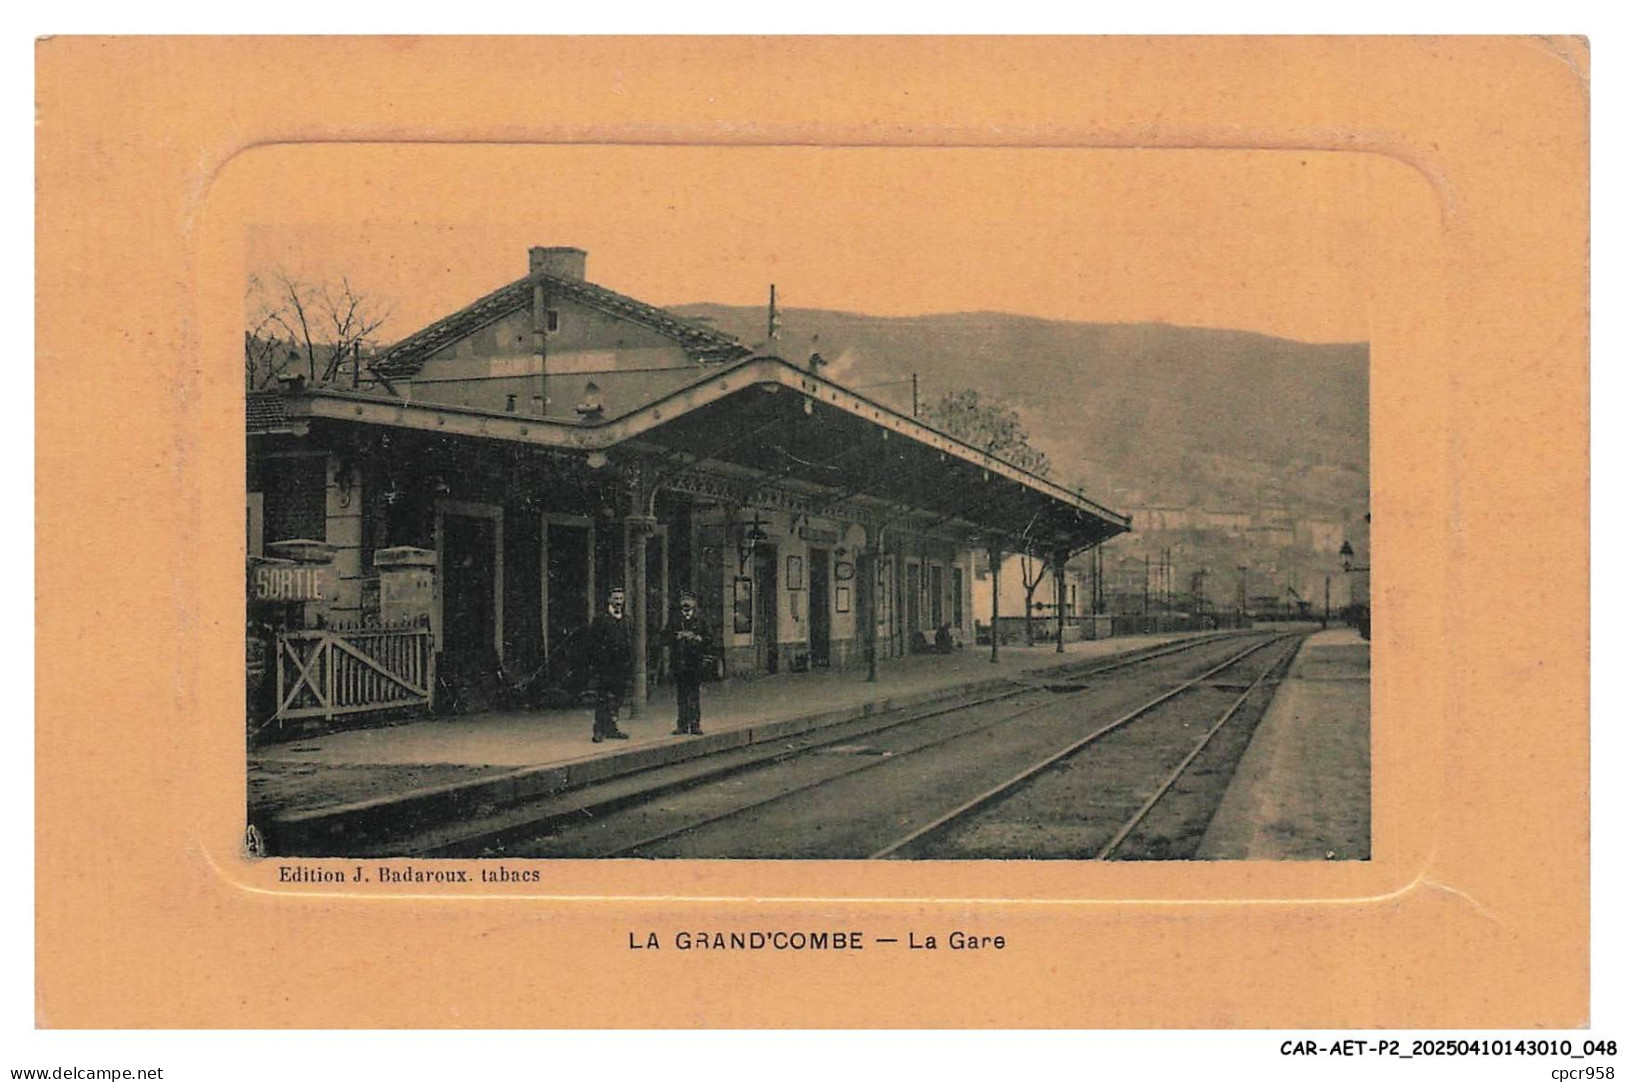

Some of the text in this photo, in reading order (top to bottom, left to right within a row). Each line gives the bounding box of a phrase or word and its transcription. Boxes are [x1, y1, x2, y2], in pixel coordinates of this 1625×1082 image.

[257, 568, 326, 600] SORTIE
[279, 866, 345, 883] Edition
[353, 866, 369, 883] J.
[481, 866, 540, 883] tabacs
[629, 932, 660, 950] LA
[675, 931, 863, 950] GRAND'COMBE
[909, 931, 937, 950] La
[949, 931, 1006, 950] Gare
